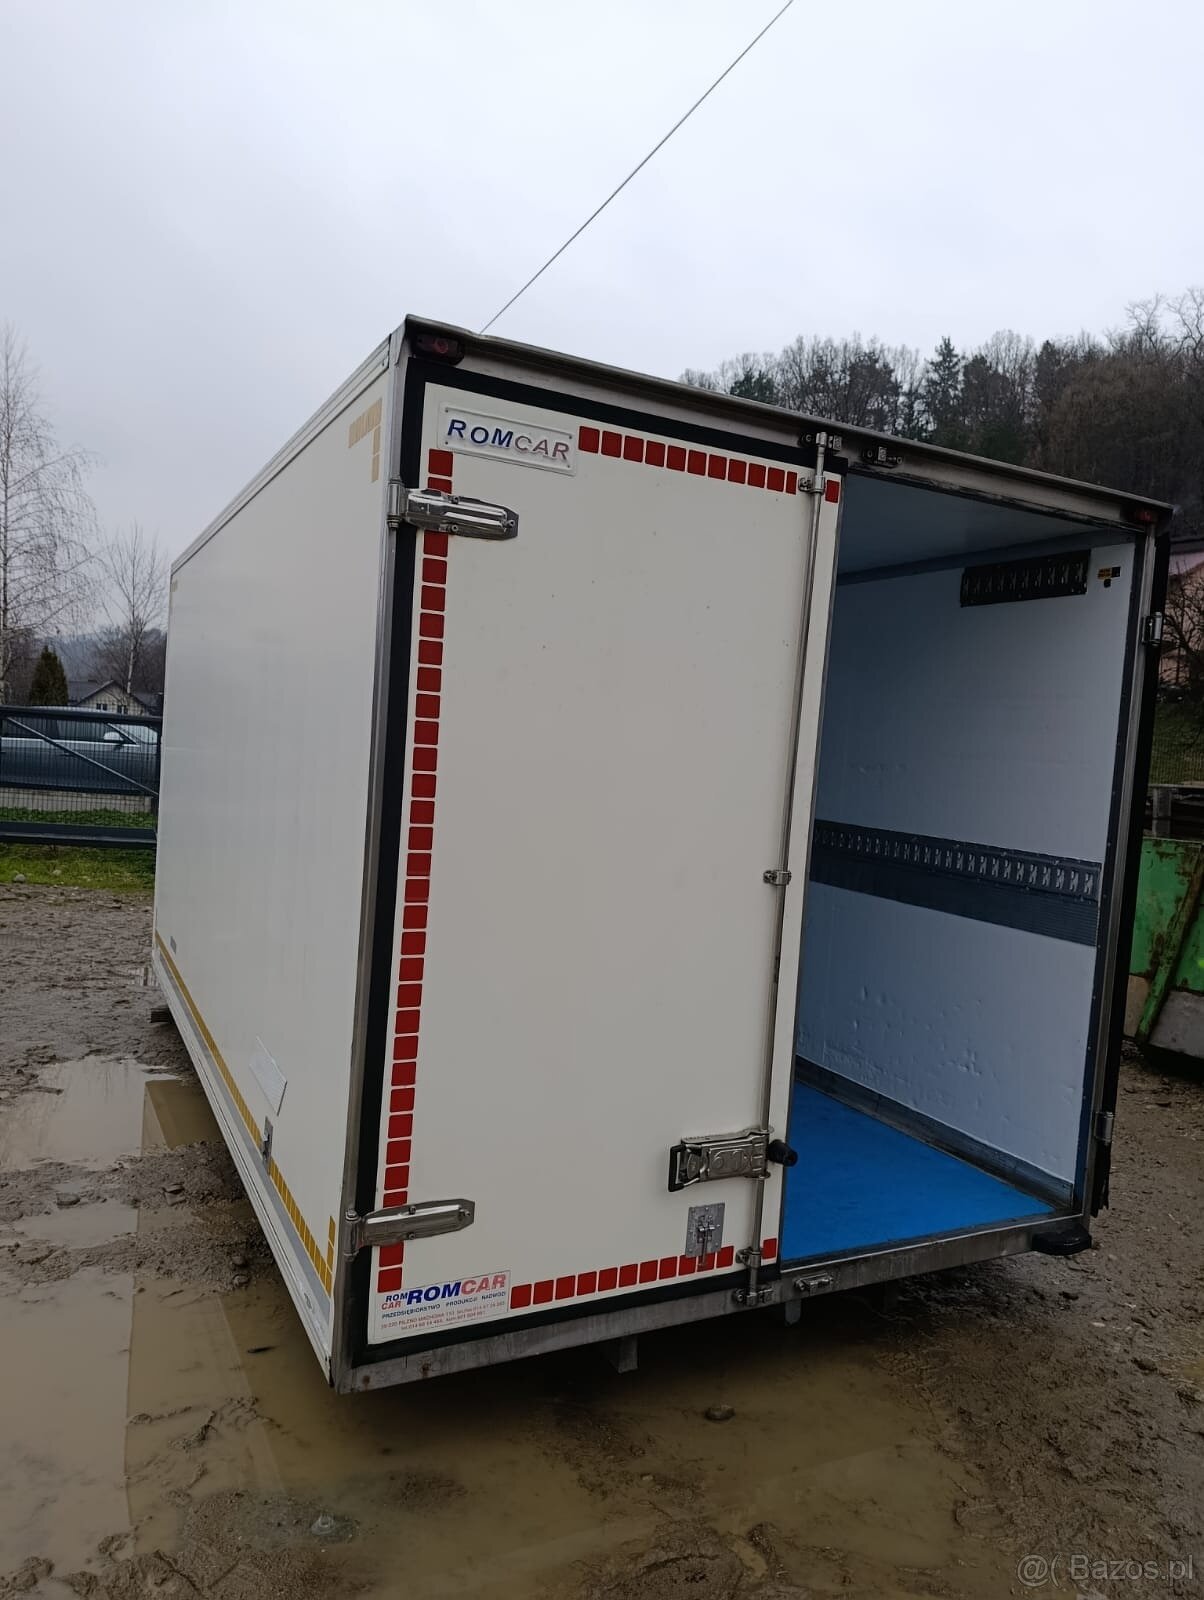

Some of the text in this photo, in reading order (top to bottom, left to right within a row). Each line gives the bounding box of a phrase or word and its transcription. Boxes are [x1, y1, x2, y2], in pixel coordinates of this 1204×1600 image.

[447, 418, 570, 461] ROMCAR
[385, 1292, 408, 1303] ROM
[407, 1274, 506, 1305] ROMCAR
[381, 1300, 401, 1310] CAR
